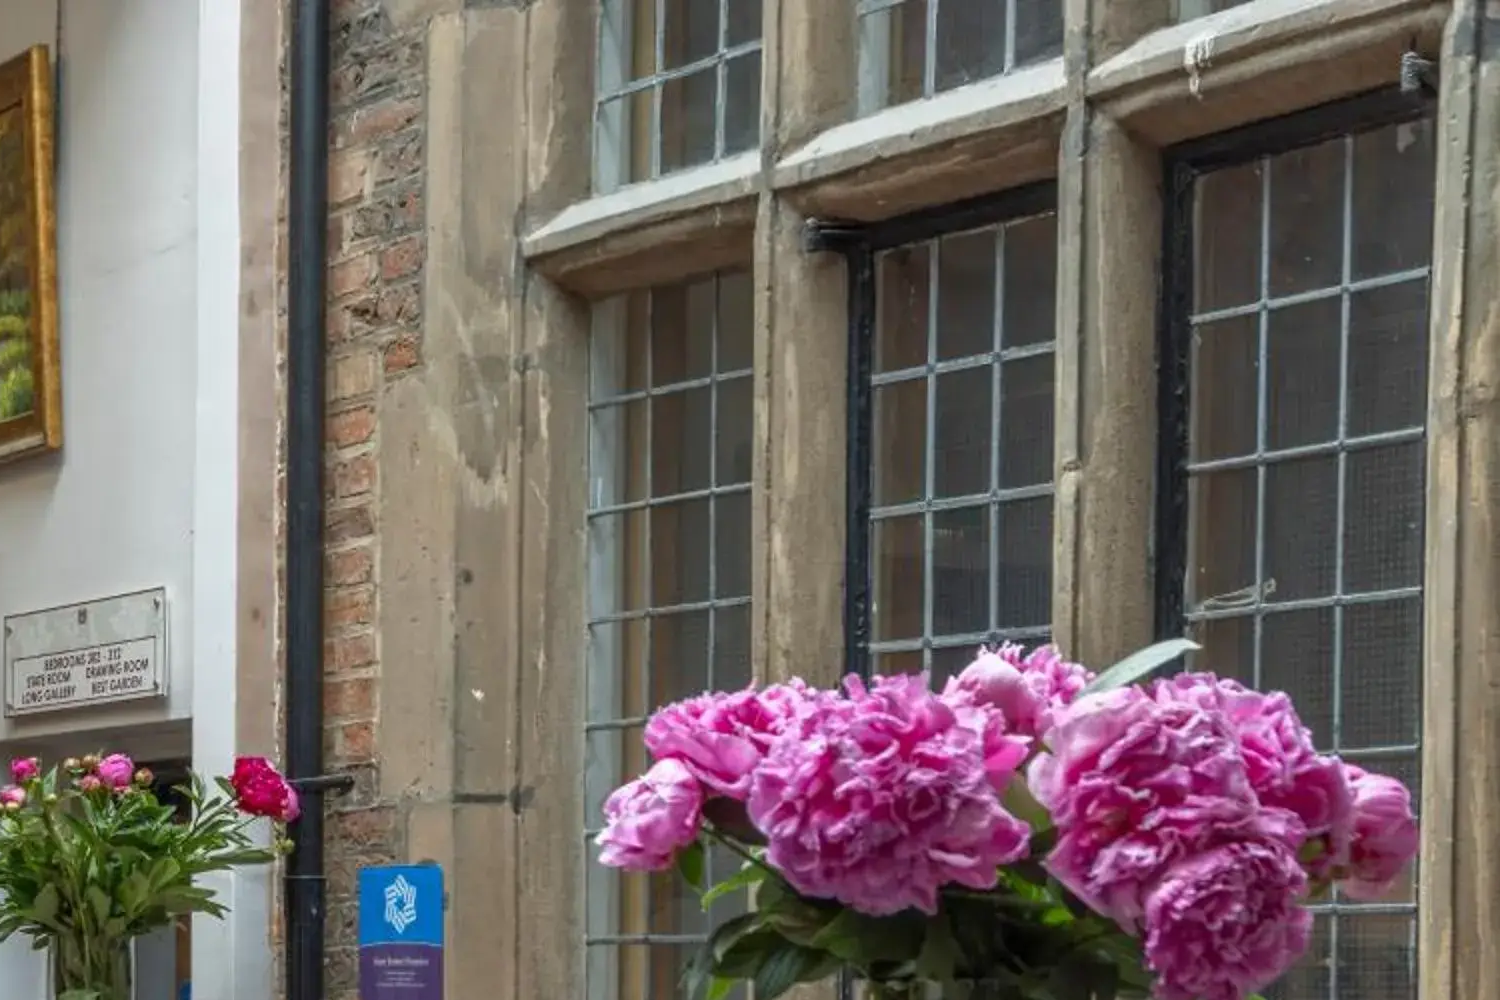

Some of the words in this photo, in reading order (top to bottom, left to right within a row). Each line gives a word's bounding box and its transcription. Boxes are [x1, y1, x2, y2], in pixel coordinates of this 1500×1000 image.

[44, 654, 86, 671] BEDROOMS
[86, 662, 122, 679] DRAWING
[123, 657, 149, 673] ROOM
[46, 670, 71, 685] ROOM
[21, 691, 43, 705] LONG
[43, 685, 77, 701] GALLERY
